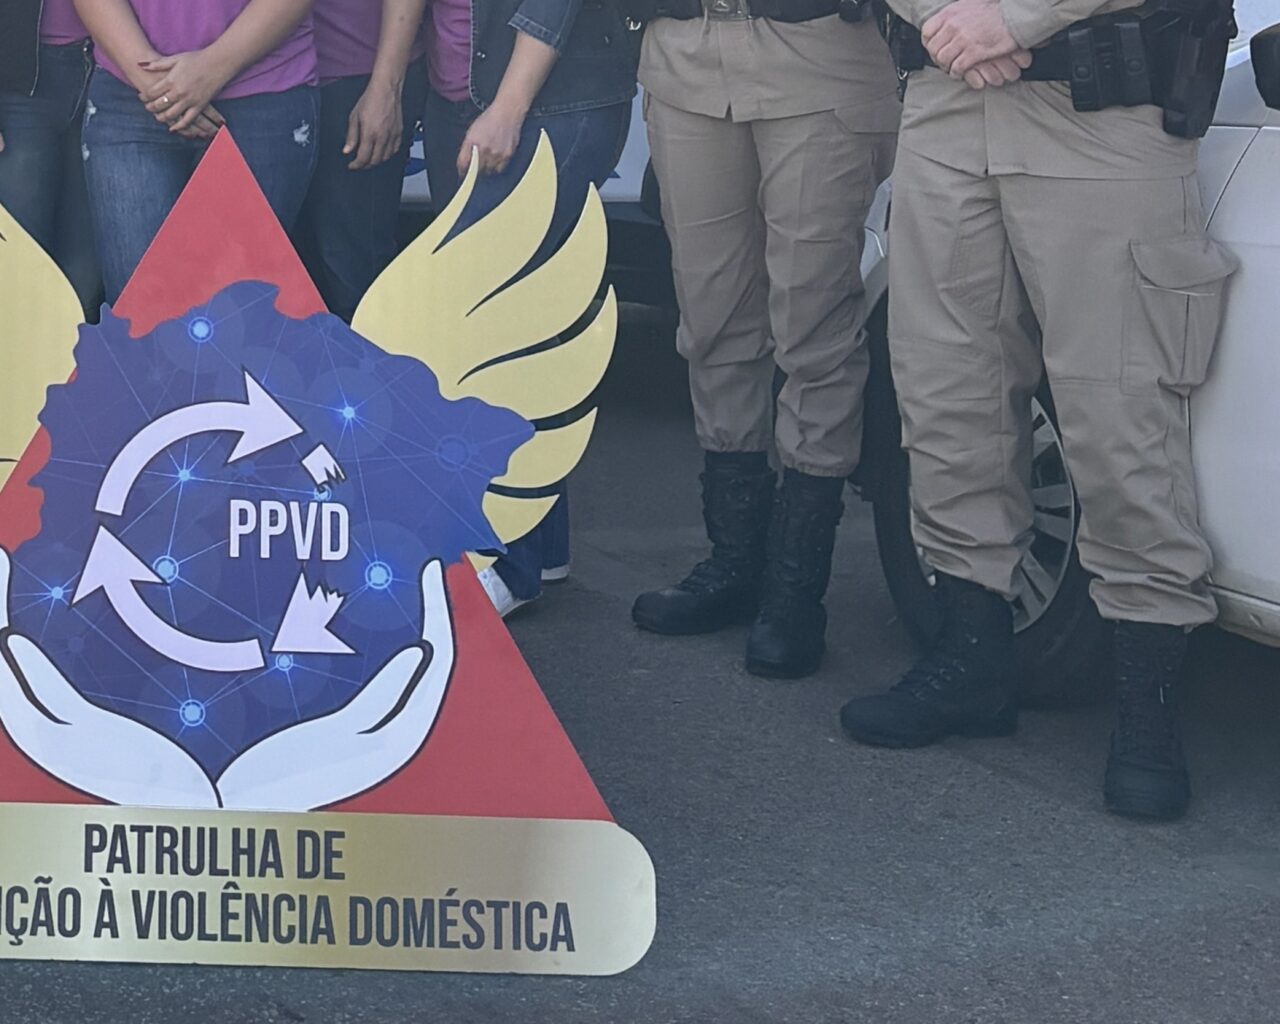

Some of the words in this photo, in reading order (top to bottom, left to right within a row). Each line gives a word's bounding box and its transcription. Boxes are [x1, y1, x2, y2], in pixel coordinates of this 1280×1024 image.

[229, 499, 349, 561] PPVD
[83, 823, 284, 878] PATRULHA
[296, 829, 346, 881] DE
[93, 877, 119, 939] À
[131, 881, 336, 946] VIOLÊNCIA
[348, 888, 576, 953] DOMÉSTICA
